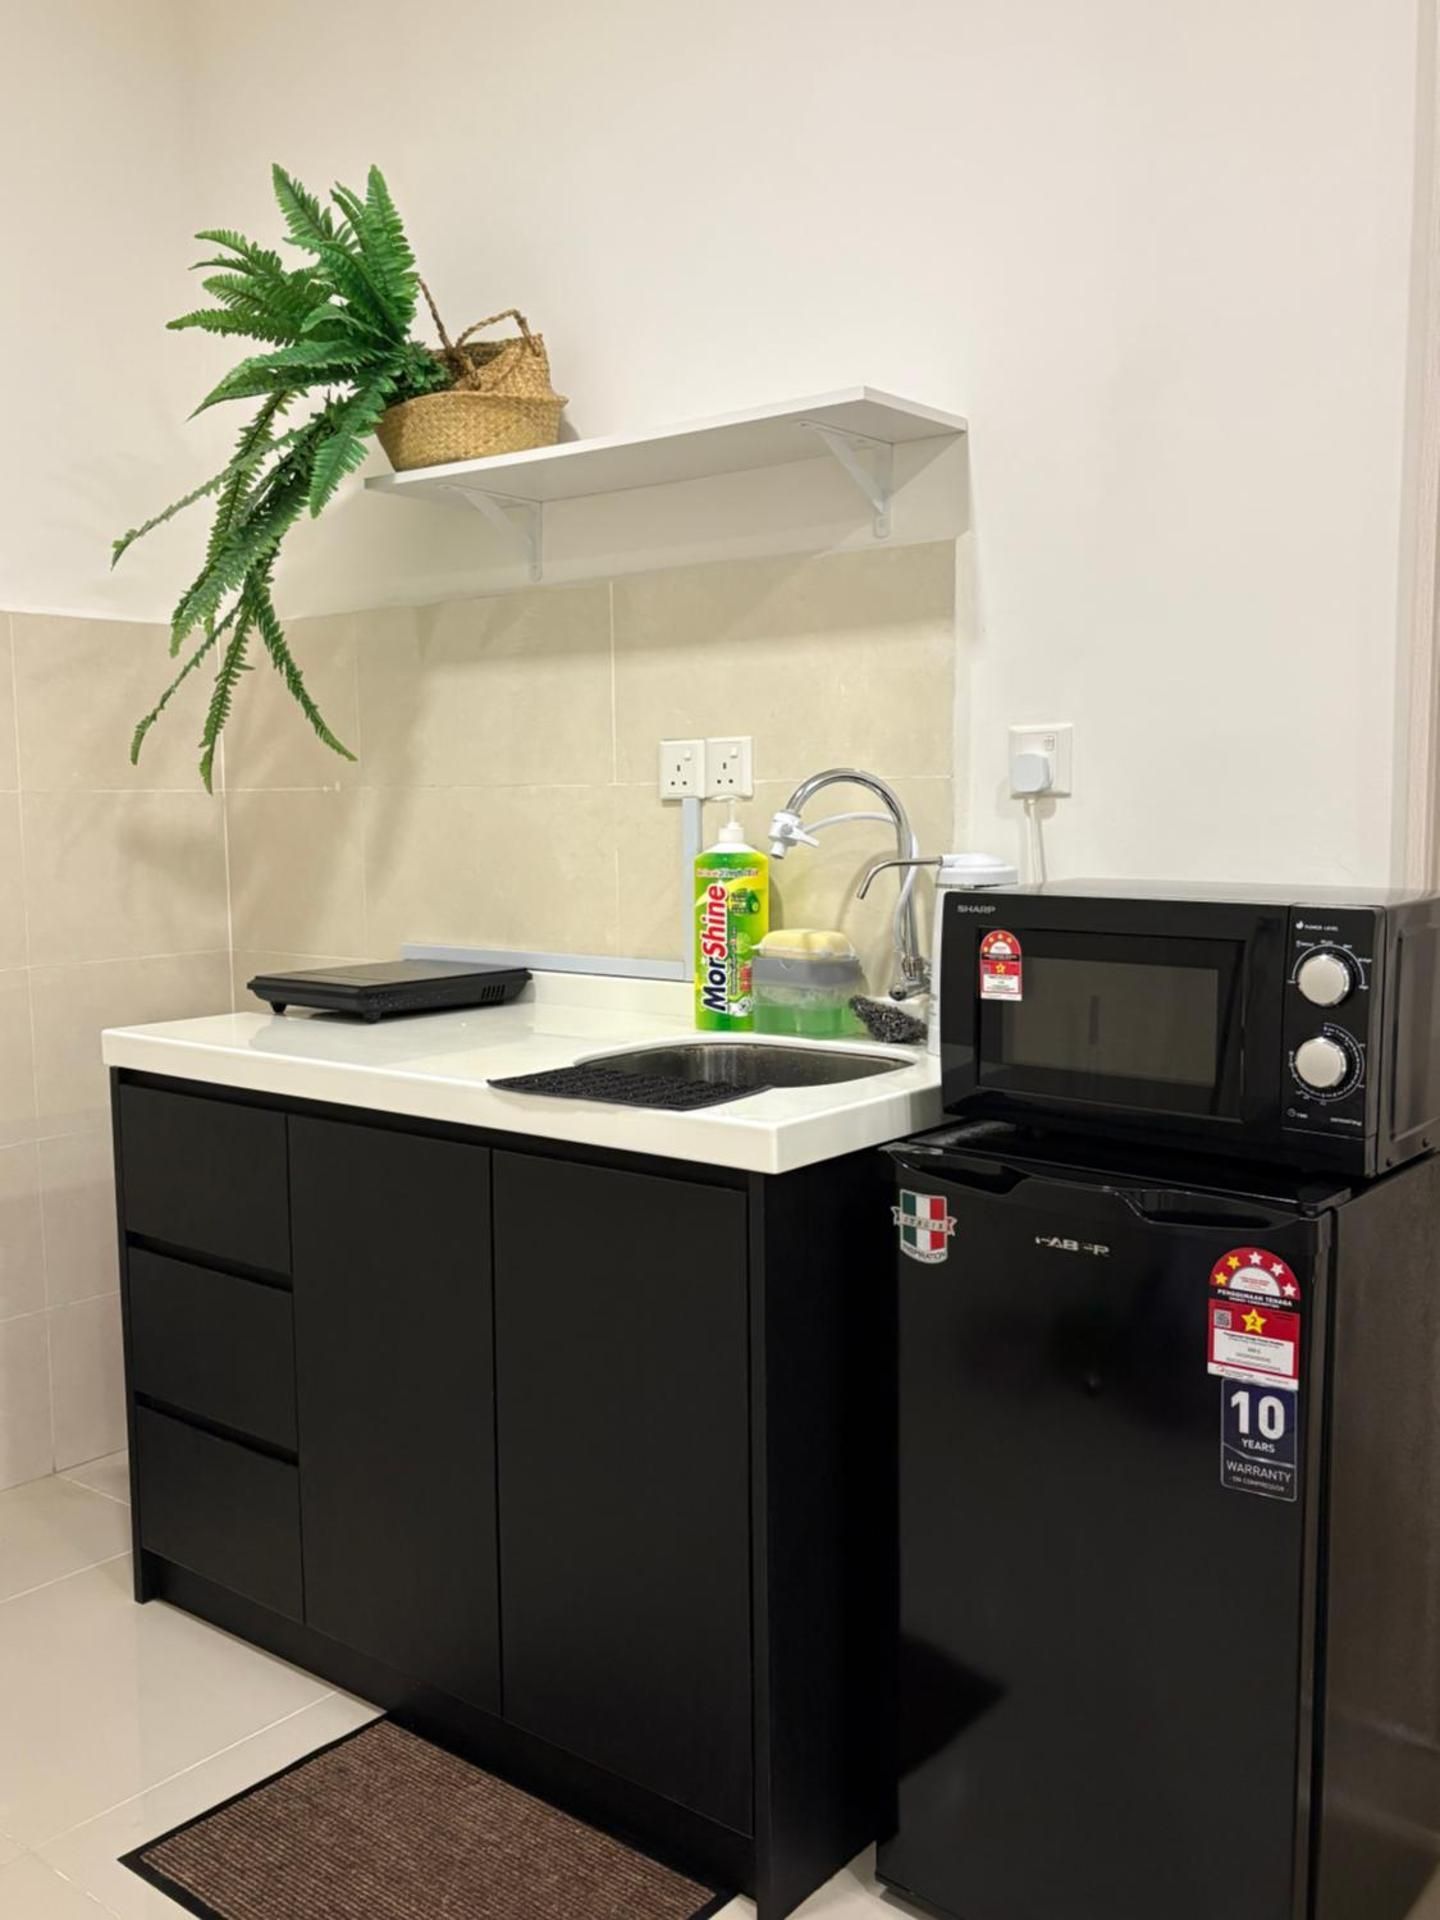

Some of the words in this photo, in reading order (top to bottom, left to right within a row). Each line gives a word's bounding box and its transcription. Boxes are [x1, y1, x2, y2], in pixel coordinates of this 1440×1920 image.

[957, 905, 996, 914] SHARP
[702, 885, 727, 1011] MorShine
[1231, 1390, 1285, 1440] 10
[1241, 1438, 1275, 1453] YEARS
[1226, 1460, 1291, 1483] WARRANTY
